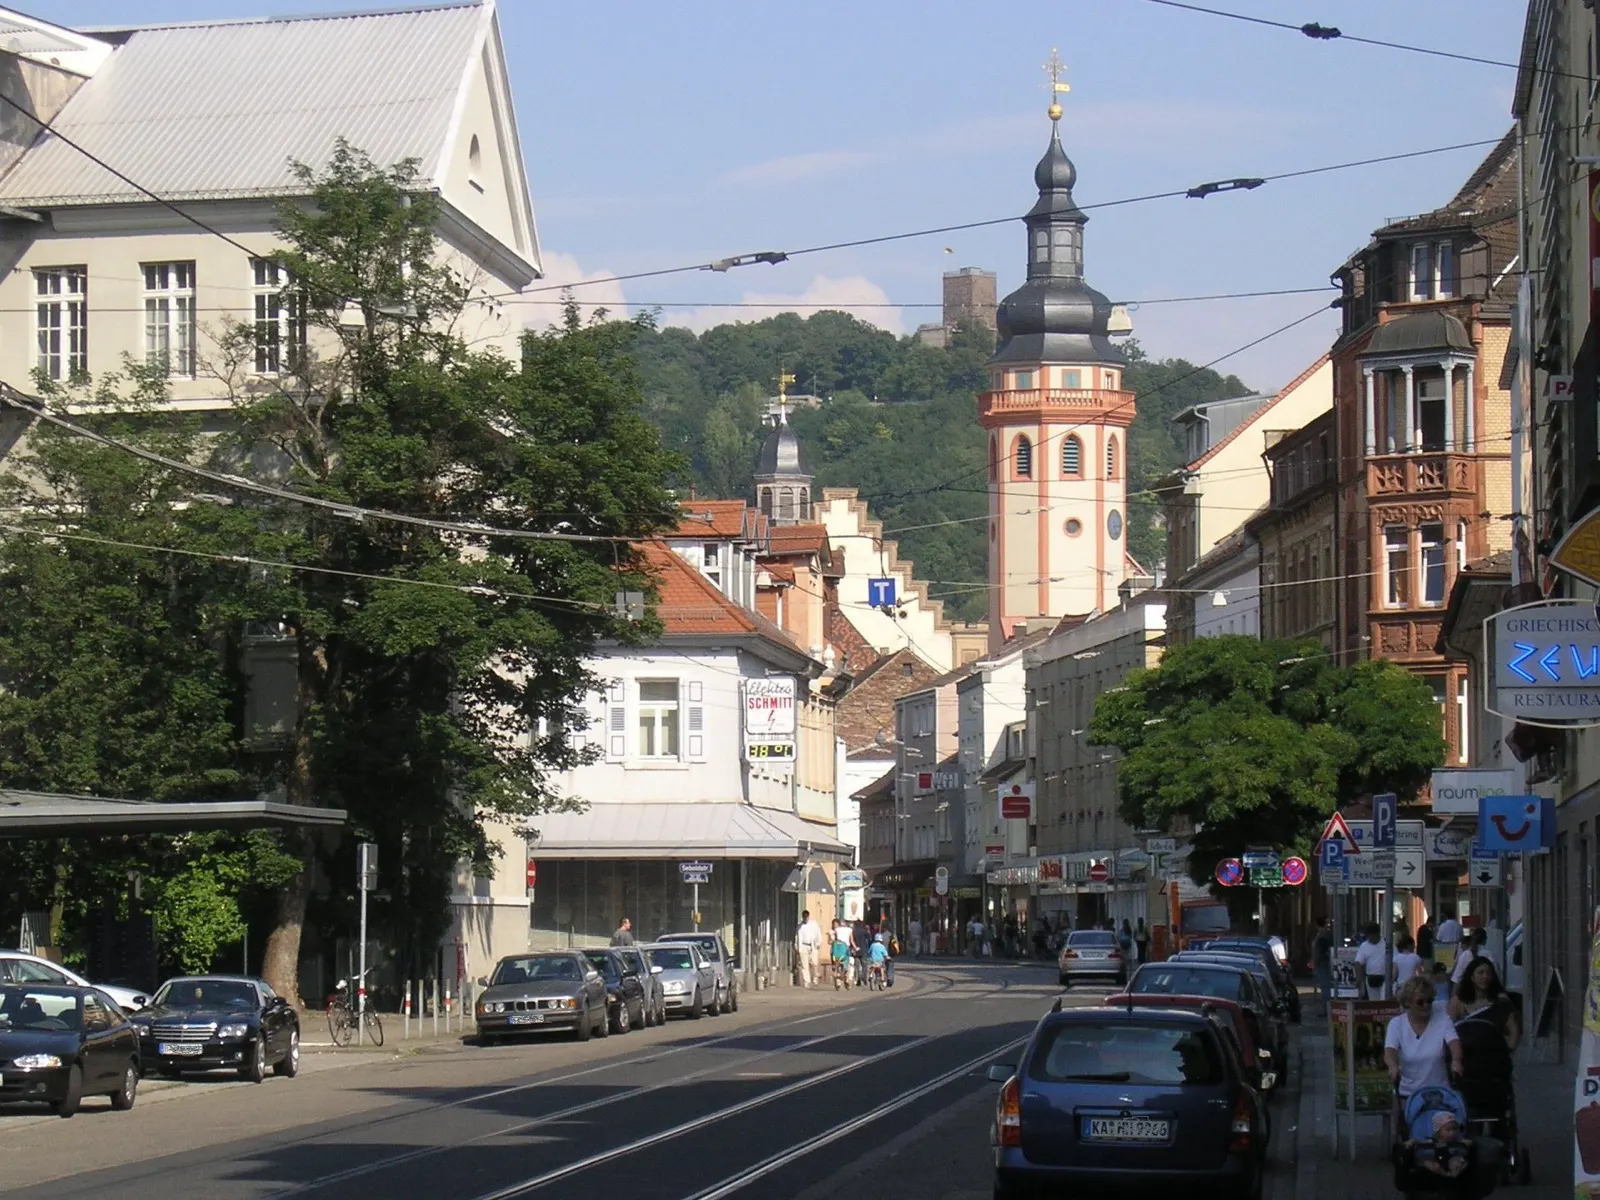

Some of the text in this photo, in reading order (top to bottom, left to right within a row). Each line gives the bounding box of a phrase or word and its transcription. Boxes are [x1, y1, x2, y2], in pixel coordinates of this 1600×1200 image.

[749, 697, 793, 709] SCHMITT
[1379, 802, 1391, 841] P
[1326, 843, 1339, 864] P
